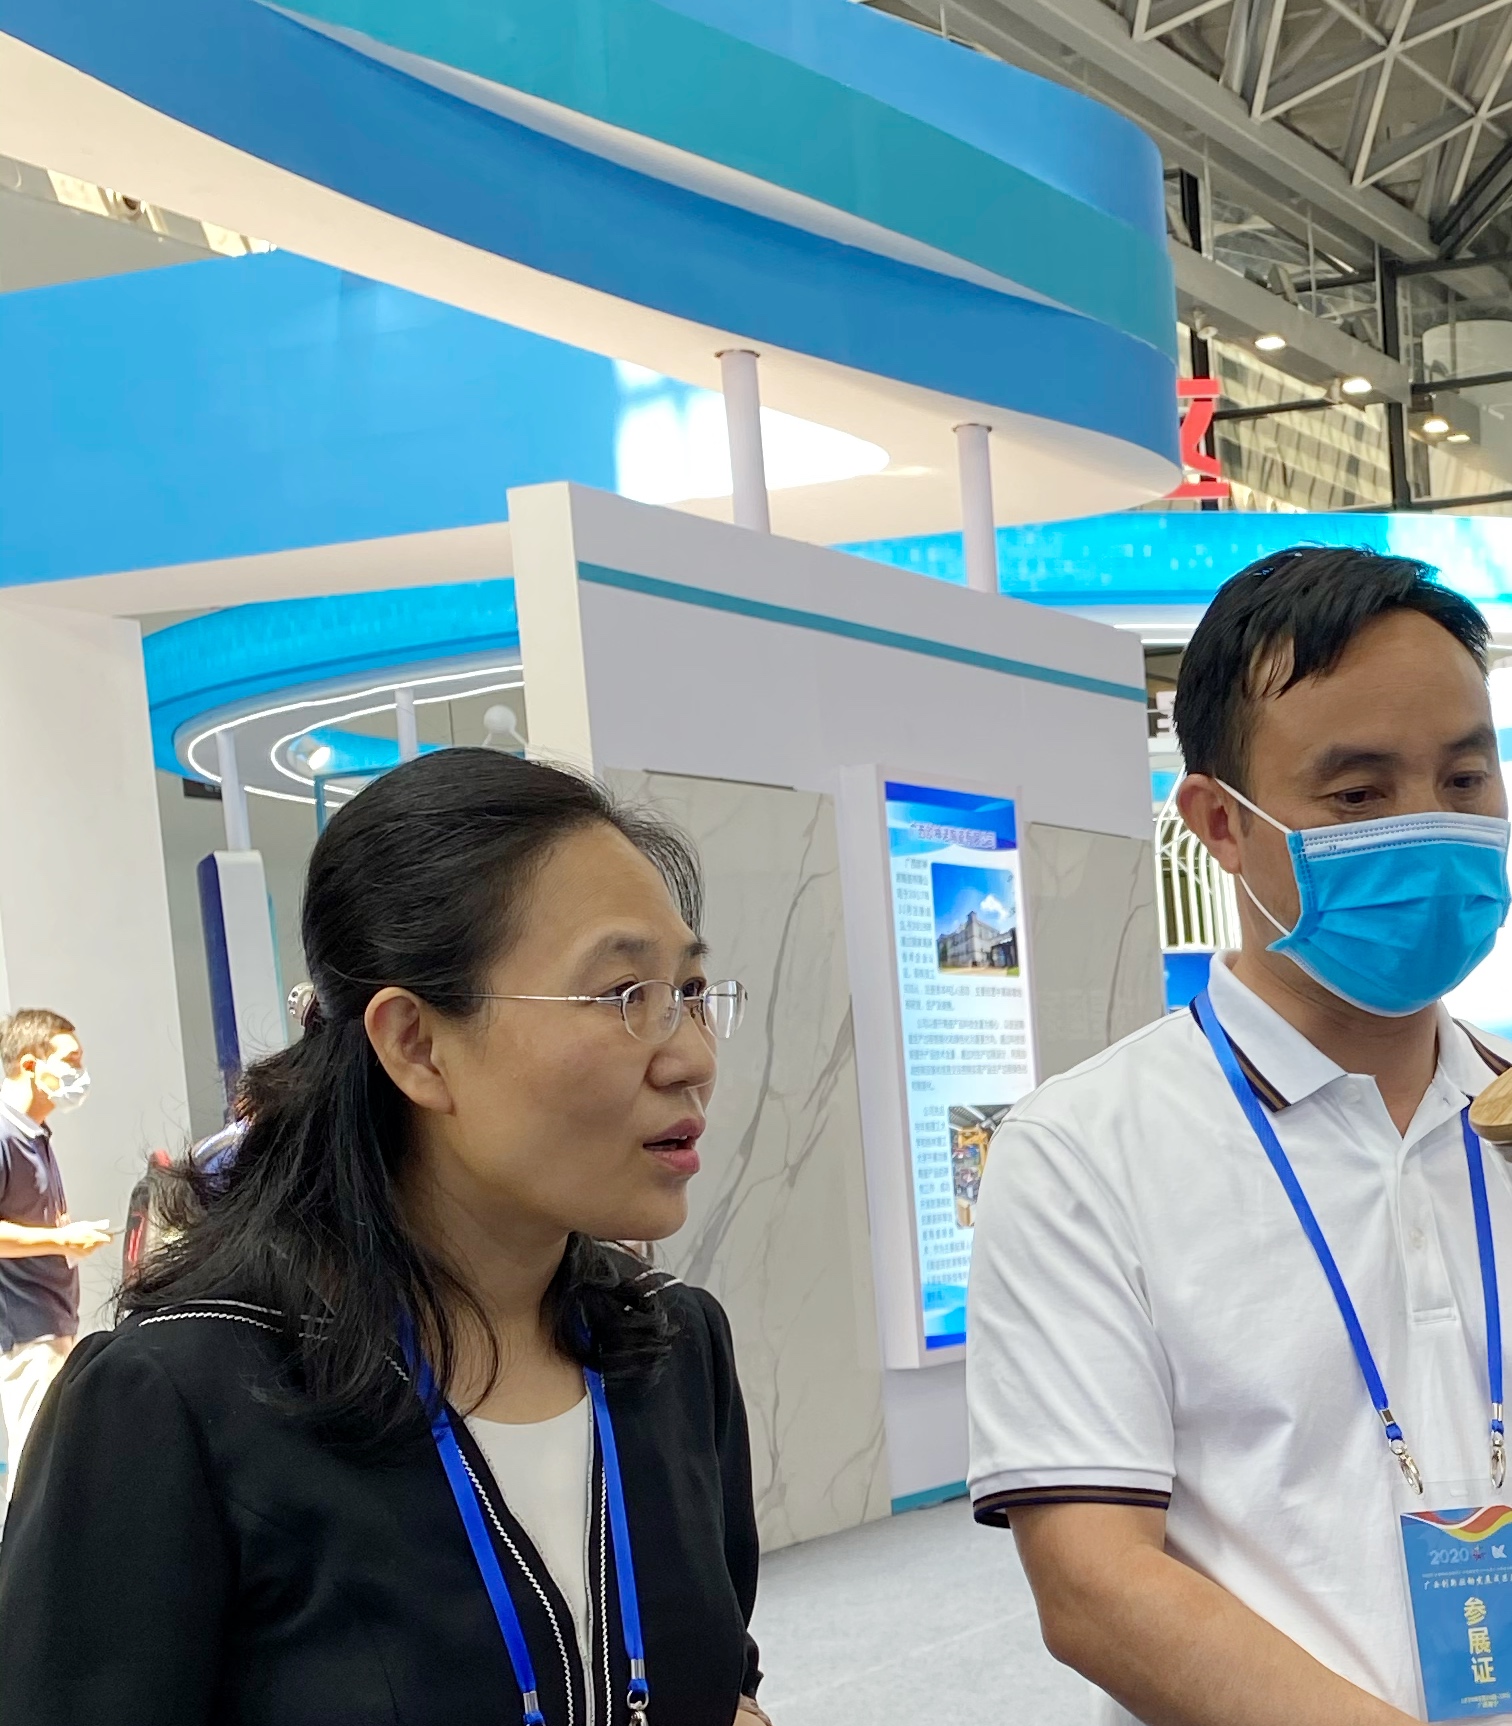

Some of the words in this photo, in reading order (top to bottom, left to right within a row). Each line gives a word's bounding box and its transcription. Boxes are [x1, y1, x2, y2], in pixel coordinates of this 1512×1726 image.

[1429, 1547, 1470, 1566] 2020
[1463, 1596, 1497, 1684] 参展证
